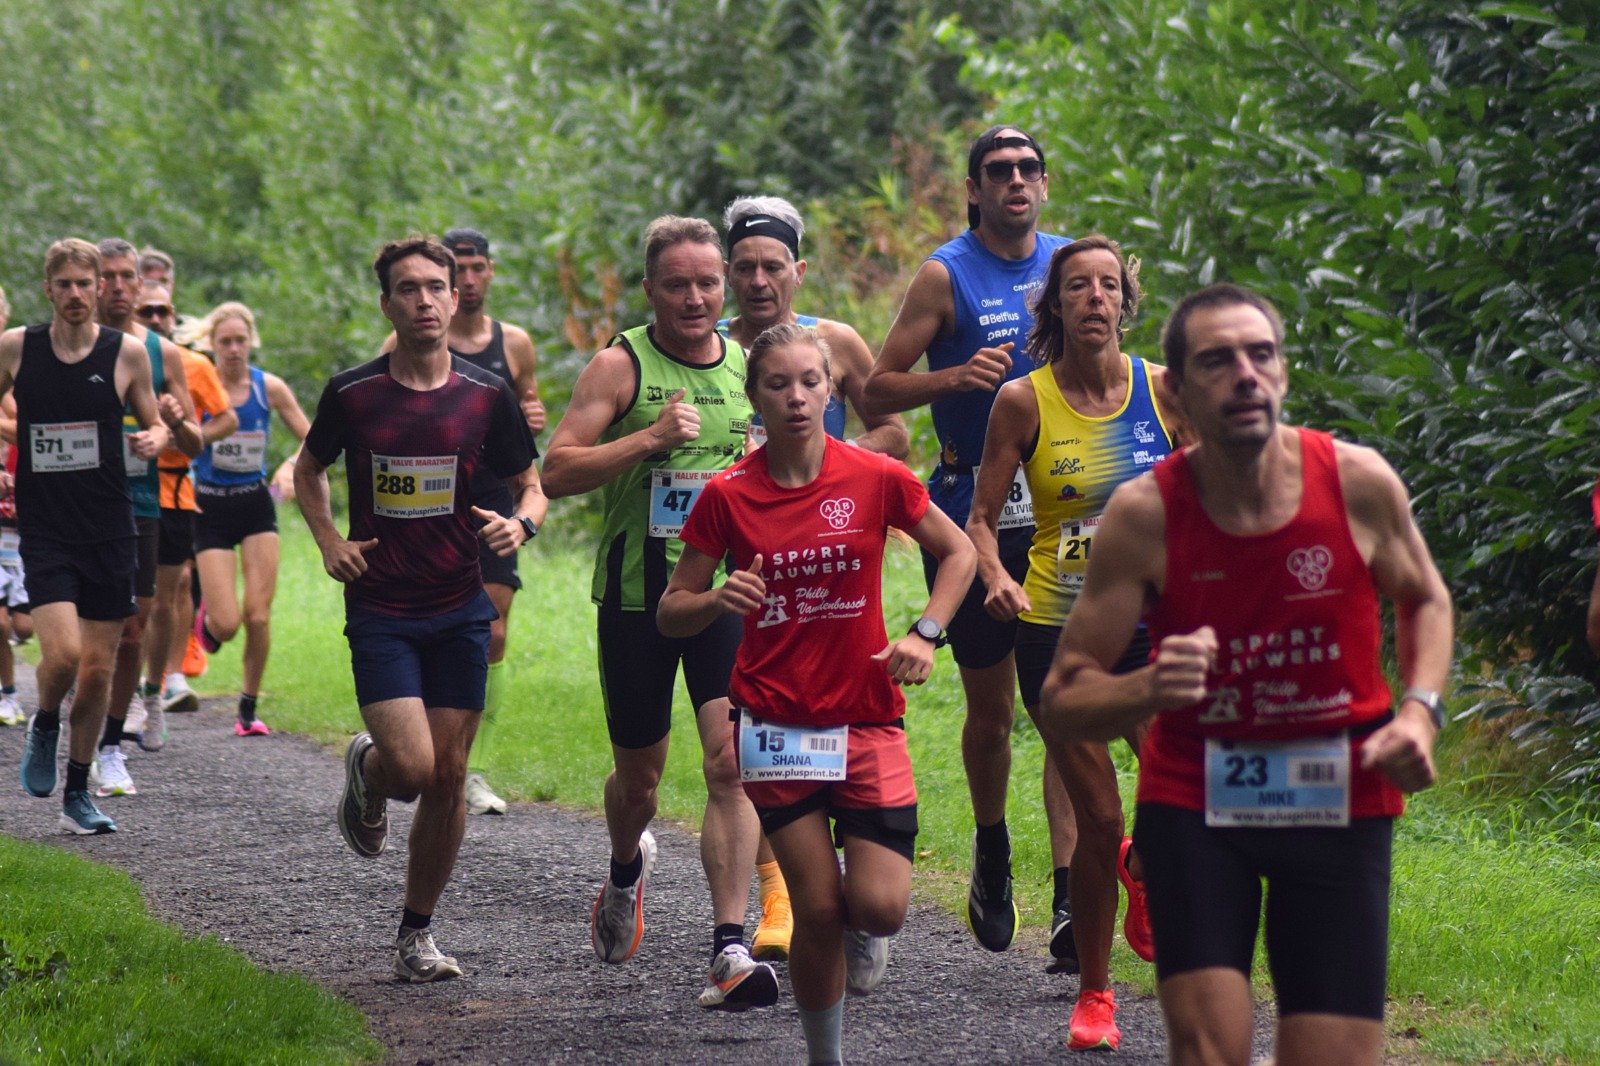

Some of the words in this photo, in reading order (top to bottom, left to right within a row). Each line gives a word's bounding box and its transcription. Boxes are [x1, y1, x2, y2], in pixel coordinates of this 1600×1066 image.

[1012, 281, 1037, 292] CRAFT
[981, 298, 1003, 308] Olivier
[989, 312, 1019, 324] Belfius
[693, 396, 726, 405] Athlex
[35, 438, 63, 454] 571
[1050, 439, 1075, 447] CRAFT
[390, 459, 414, 467] HALVE
[415, 457, 455, 467] MARATHON
[674, 472, 699, 480] HALVE
[376, 474, 416, 495] 288
[662, 490, 693, 512] 47
[386, 506, 450, 517] www.plusprint.be
[773, 544, 846, 566] SPORT
[760, 558, 861, 581] LAUWERS
[795, 586, 830, 601] Philip
[755, 730, 785, 752] 15
[772, 754, 812, 766] SHANA
[757, 768, 841, 778] www.plusprint.be
[1224, 755, 1269, 787] 23
[1258, 790, 1296, 806] MIKE
